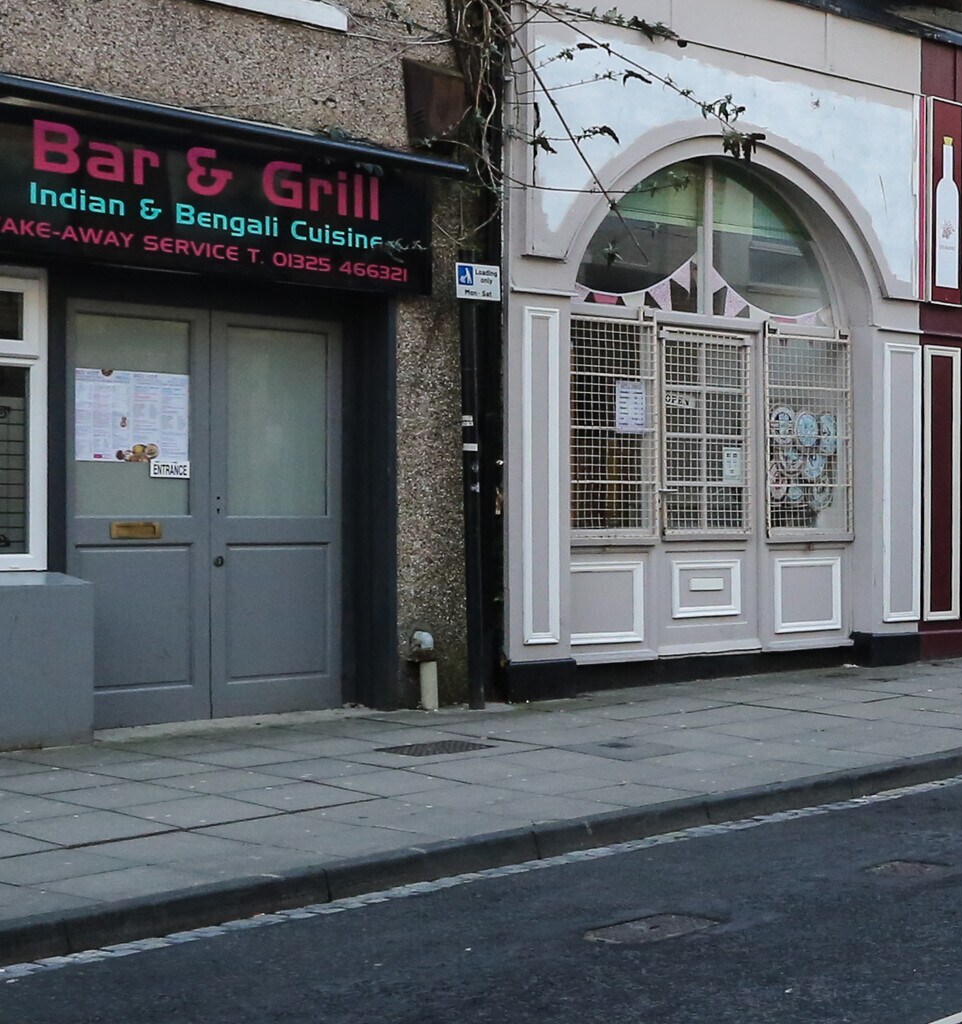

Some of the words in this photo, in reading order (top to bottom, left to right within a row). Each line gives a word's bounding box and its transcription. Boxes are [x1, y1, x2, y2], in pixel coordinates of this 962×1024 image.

[33, 119, 160, 185] Bar
[186, 146, 233, 196] &
[262, 160, 380, 221] Grill
[29, 181, 125, 217] Indian
[139, 198, 162, 220] &
[175, 203, 279, 237] Bengali
[0, 217, 134, 248] AKE-AWAY
[143, 235, 239, 262] SERVICE
[247, 248, 264, 264] T.
[272, 251, 331, 272] 01325
[339, 261, 408, 282] 466321
[475, 269, 498, 278] Loading
[664, 394, 690, 407] OPEN
[153, 463, 187, 476] ENTRANCE
